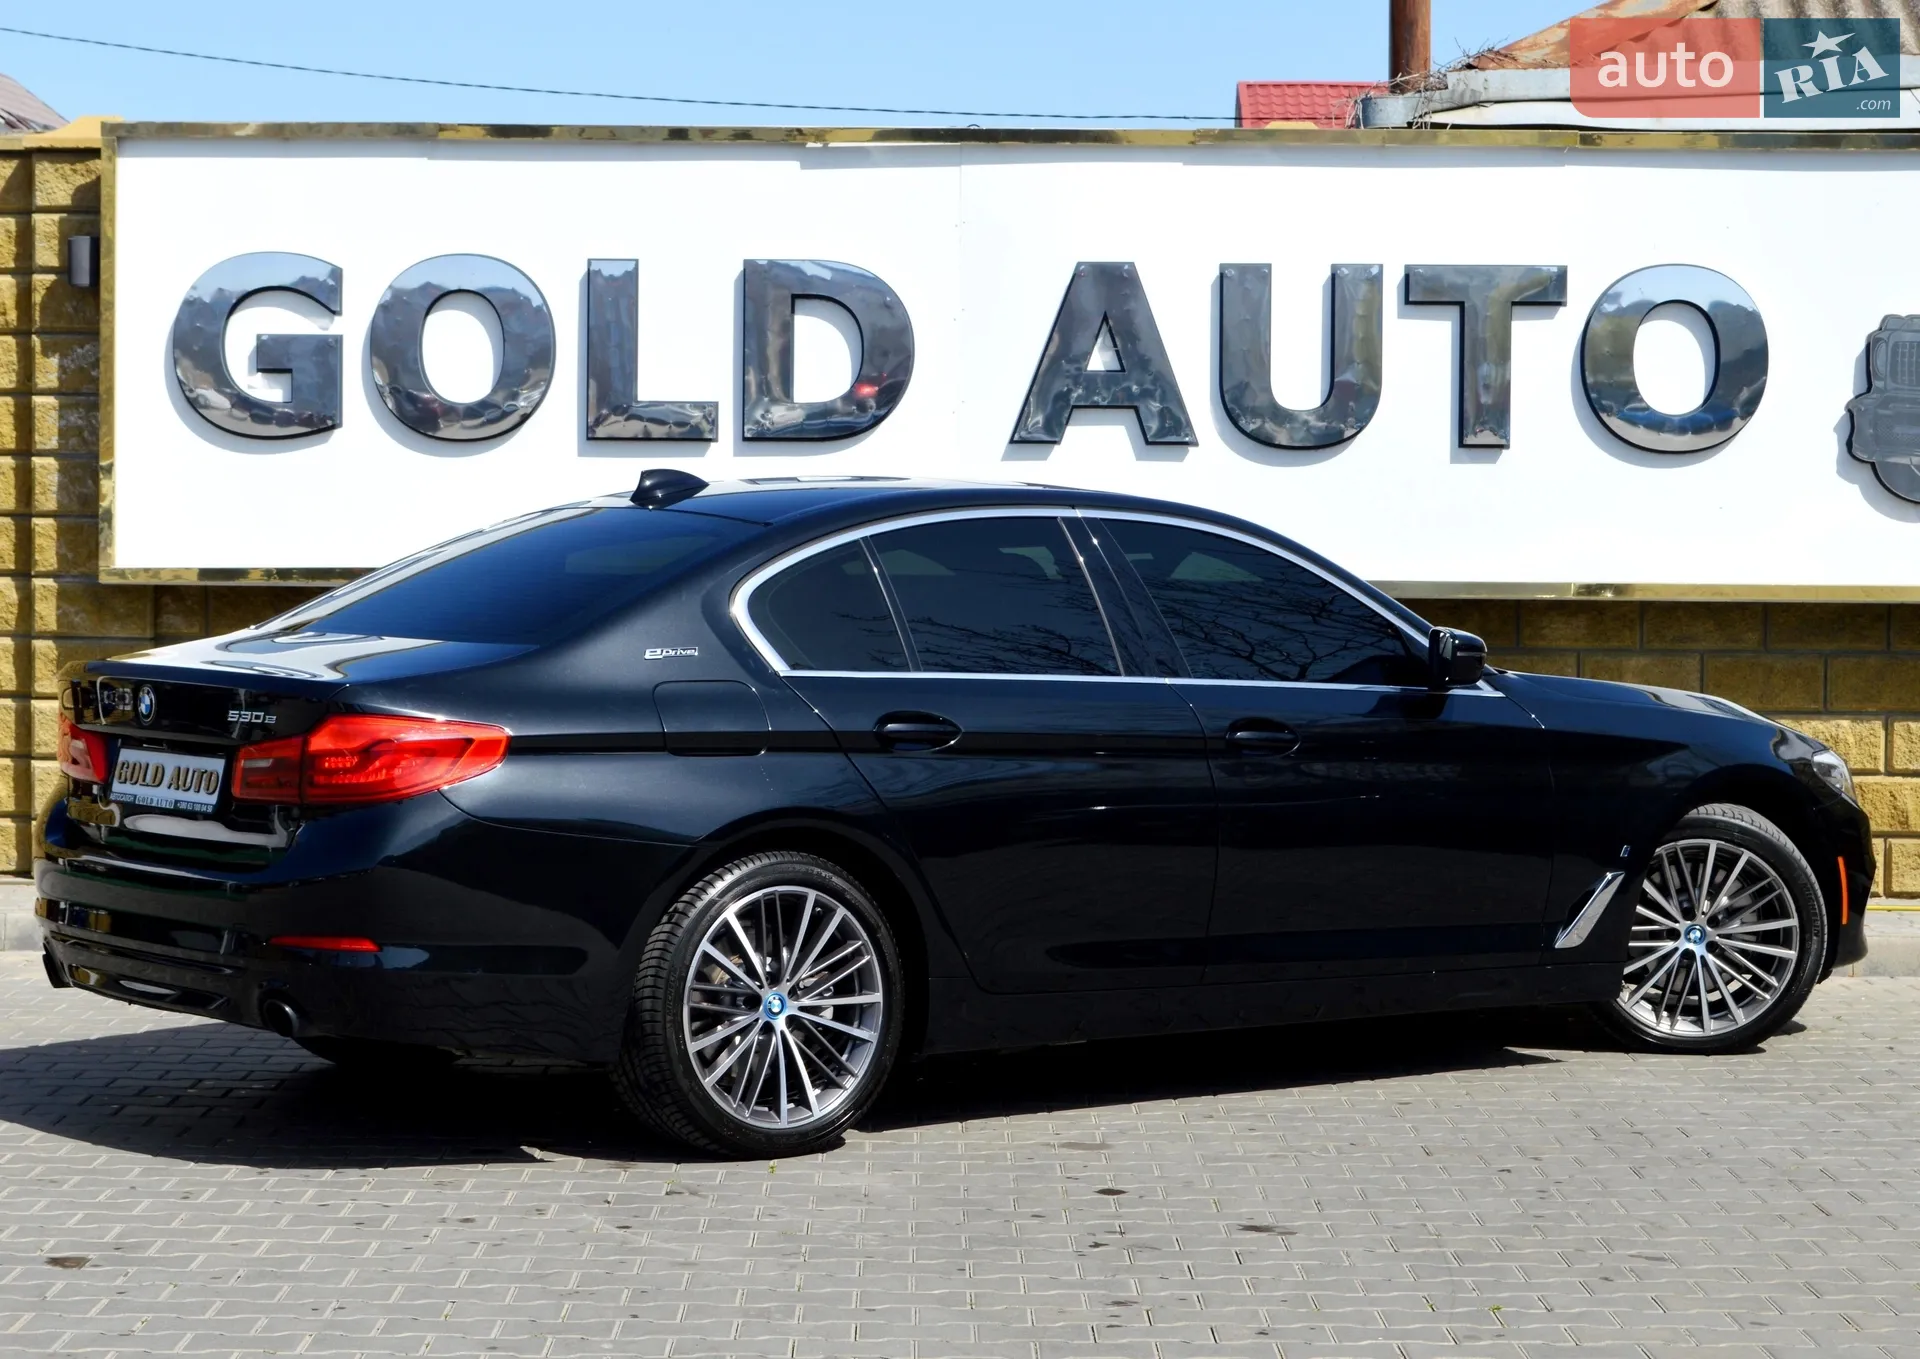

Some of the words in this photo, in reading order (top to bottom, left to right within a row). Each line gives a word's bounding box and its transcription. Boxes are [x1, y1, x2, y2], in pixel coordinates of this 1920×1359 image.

[172, 251, 915, 442] GOLD
[1008, 261, 1769, 455] AUTO
[227, 710, 277, 724] 530e
[115, 760, 165, 788] GOLD
[167, 765, 220, 795] AUTO
[137, 795, 154, 805] GOLD
